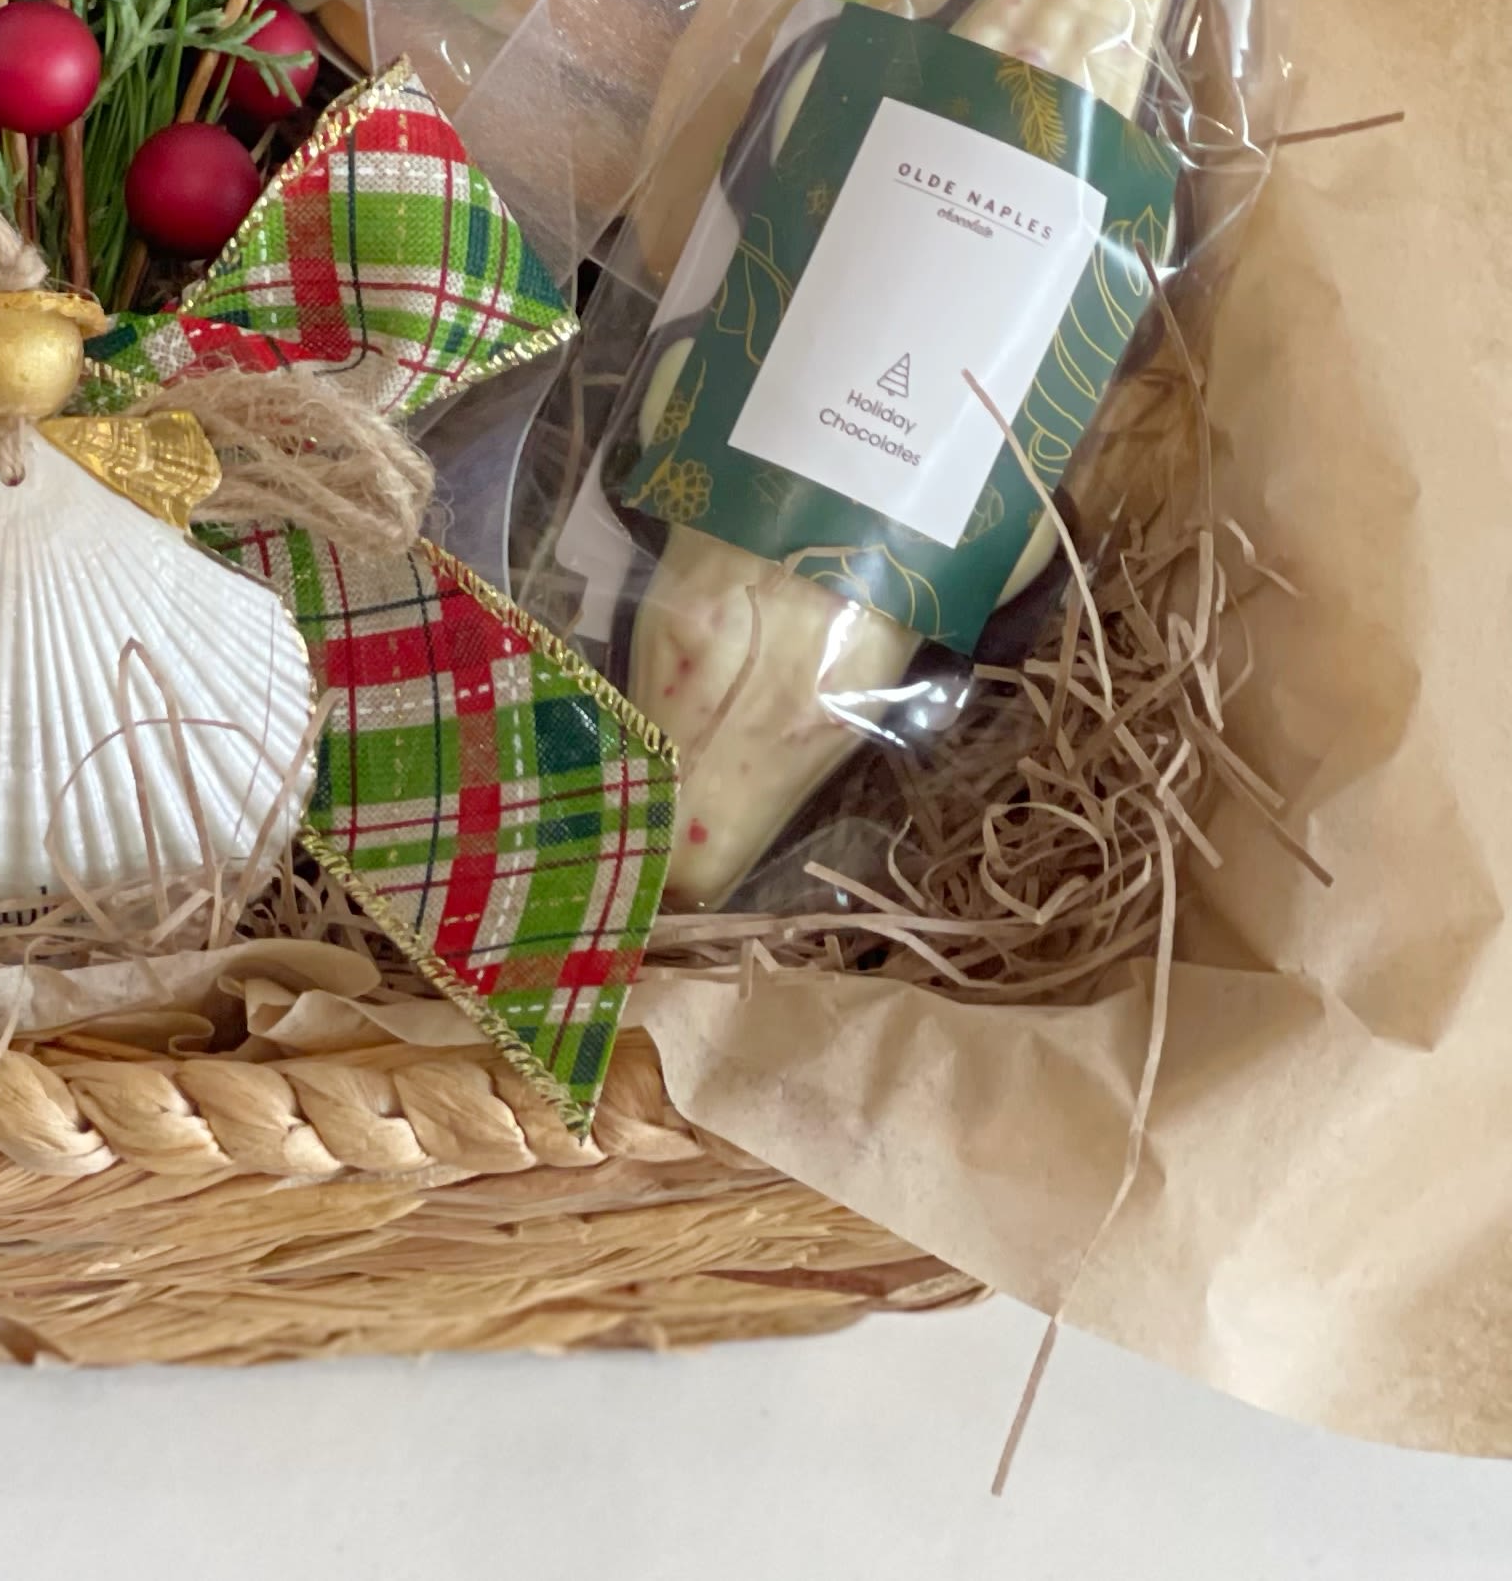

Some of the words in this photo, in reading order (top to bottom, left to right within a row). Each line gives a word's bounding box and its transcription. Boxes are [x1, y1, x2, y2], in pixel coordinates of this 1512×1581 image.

[898, 162, 956, 196] OLDE
[966, 190, 1053, 241] NAPLES
[819, 408, 922, 467] Chocolates
[846, 389, 917, 436] Holiday
